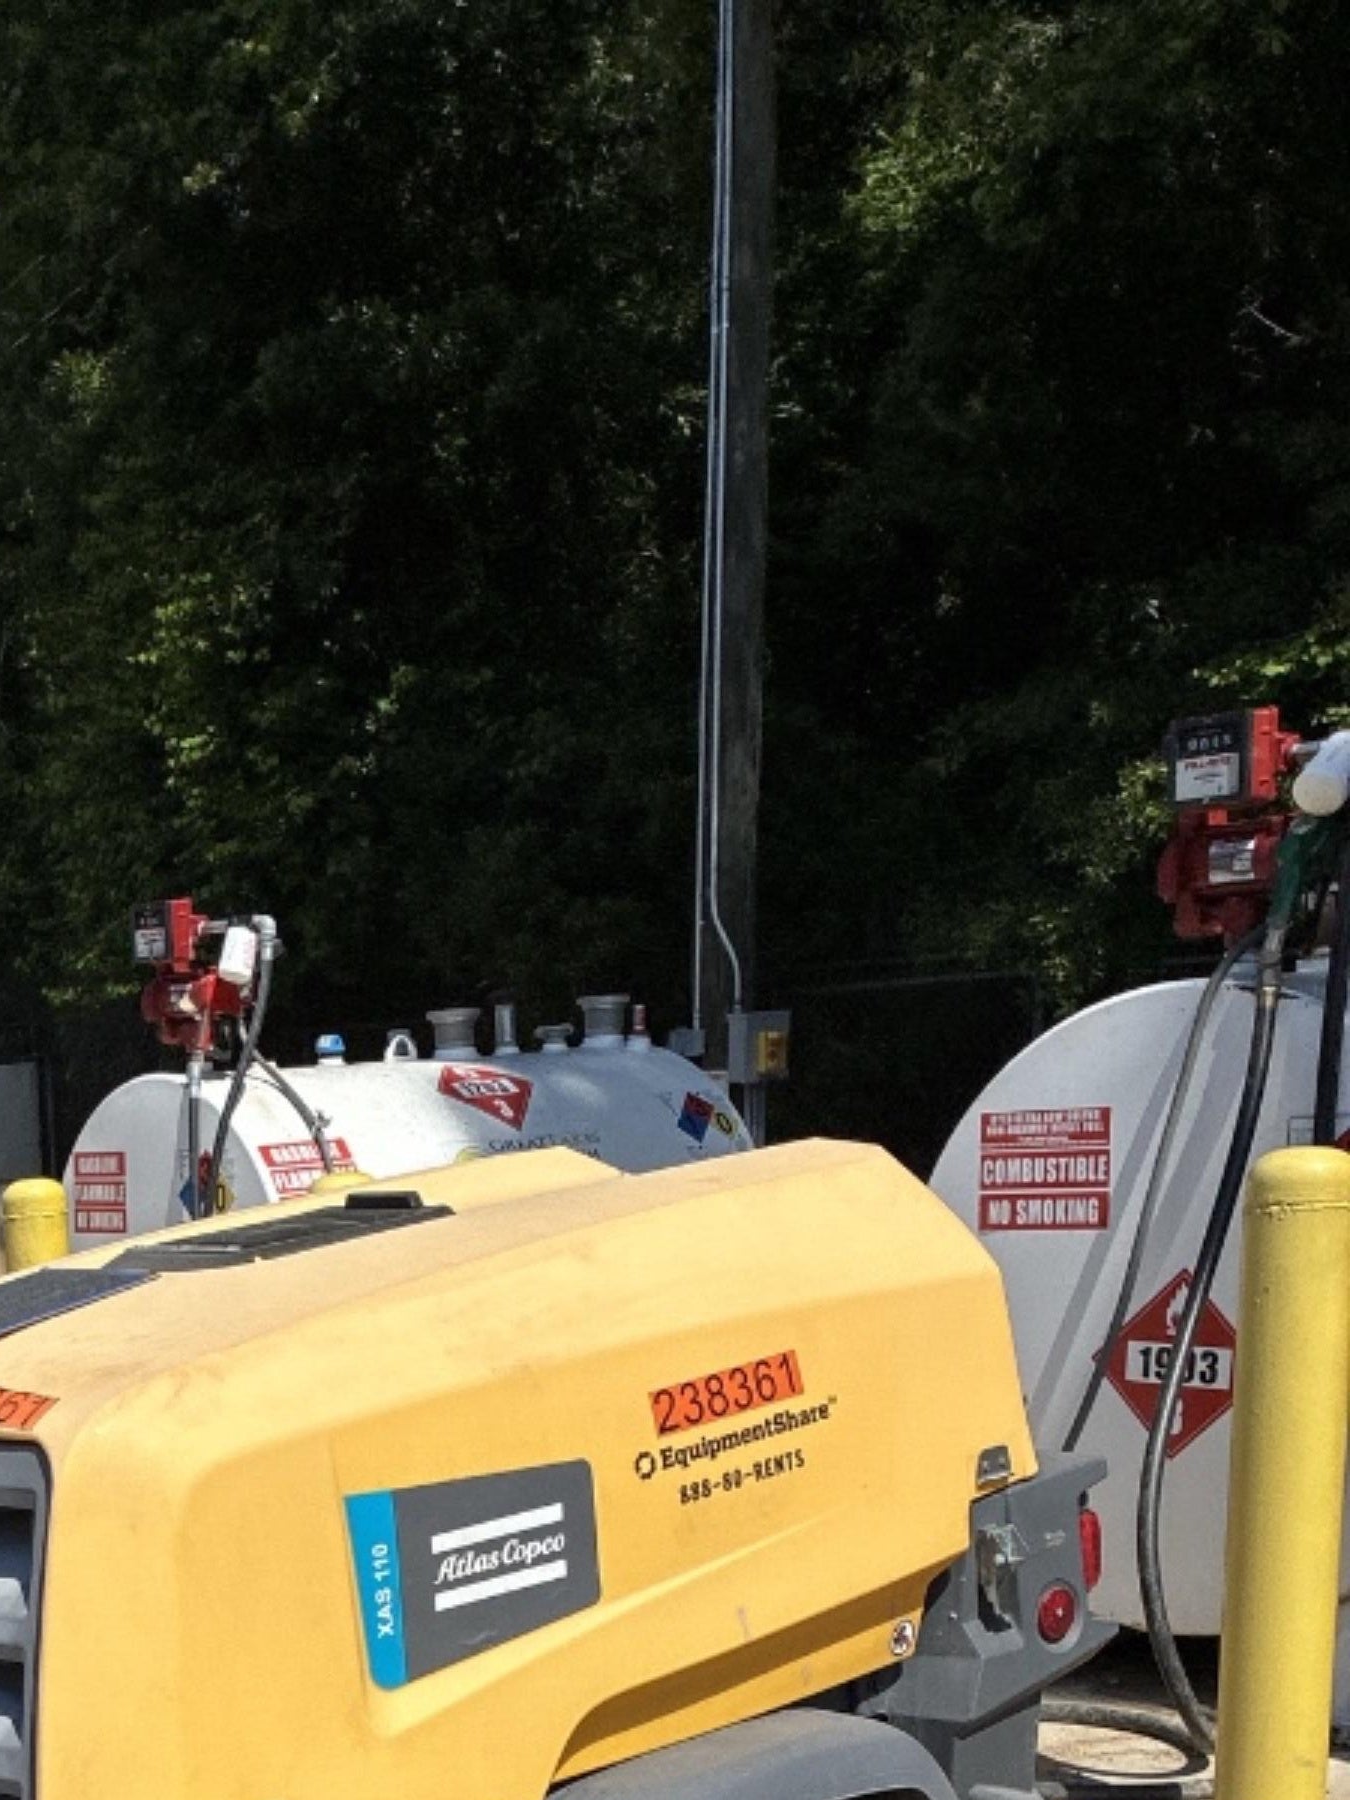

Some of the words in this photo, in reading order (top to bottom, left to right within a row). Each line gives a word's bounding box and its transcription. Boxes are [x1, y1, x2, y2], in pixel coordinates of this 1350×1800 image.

[983, 1154, 1108, 1186] COMBUSTIBLE
[988, 1199, 1012, 1225] NO
[1016, 1197, 1100, 1225] SMOKING
[653, 1352, 797, 1435] 238361
[370, 1543, 391, 1582] 110
[432, 1549, 500, 1585] Atlas
[501, 1532, 566, 1565] Copco
[377, 1586, 394, 1639] XAS
